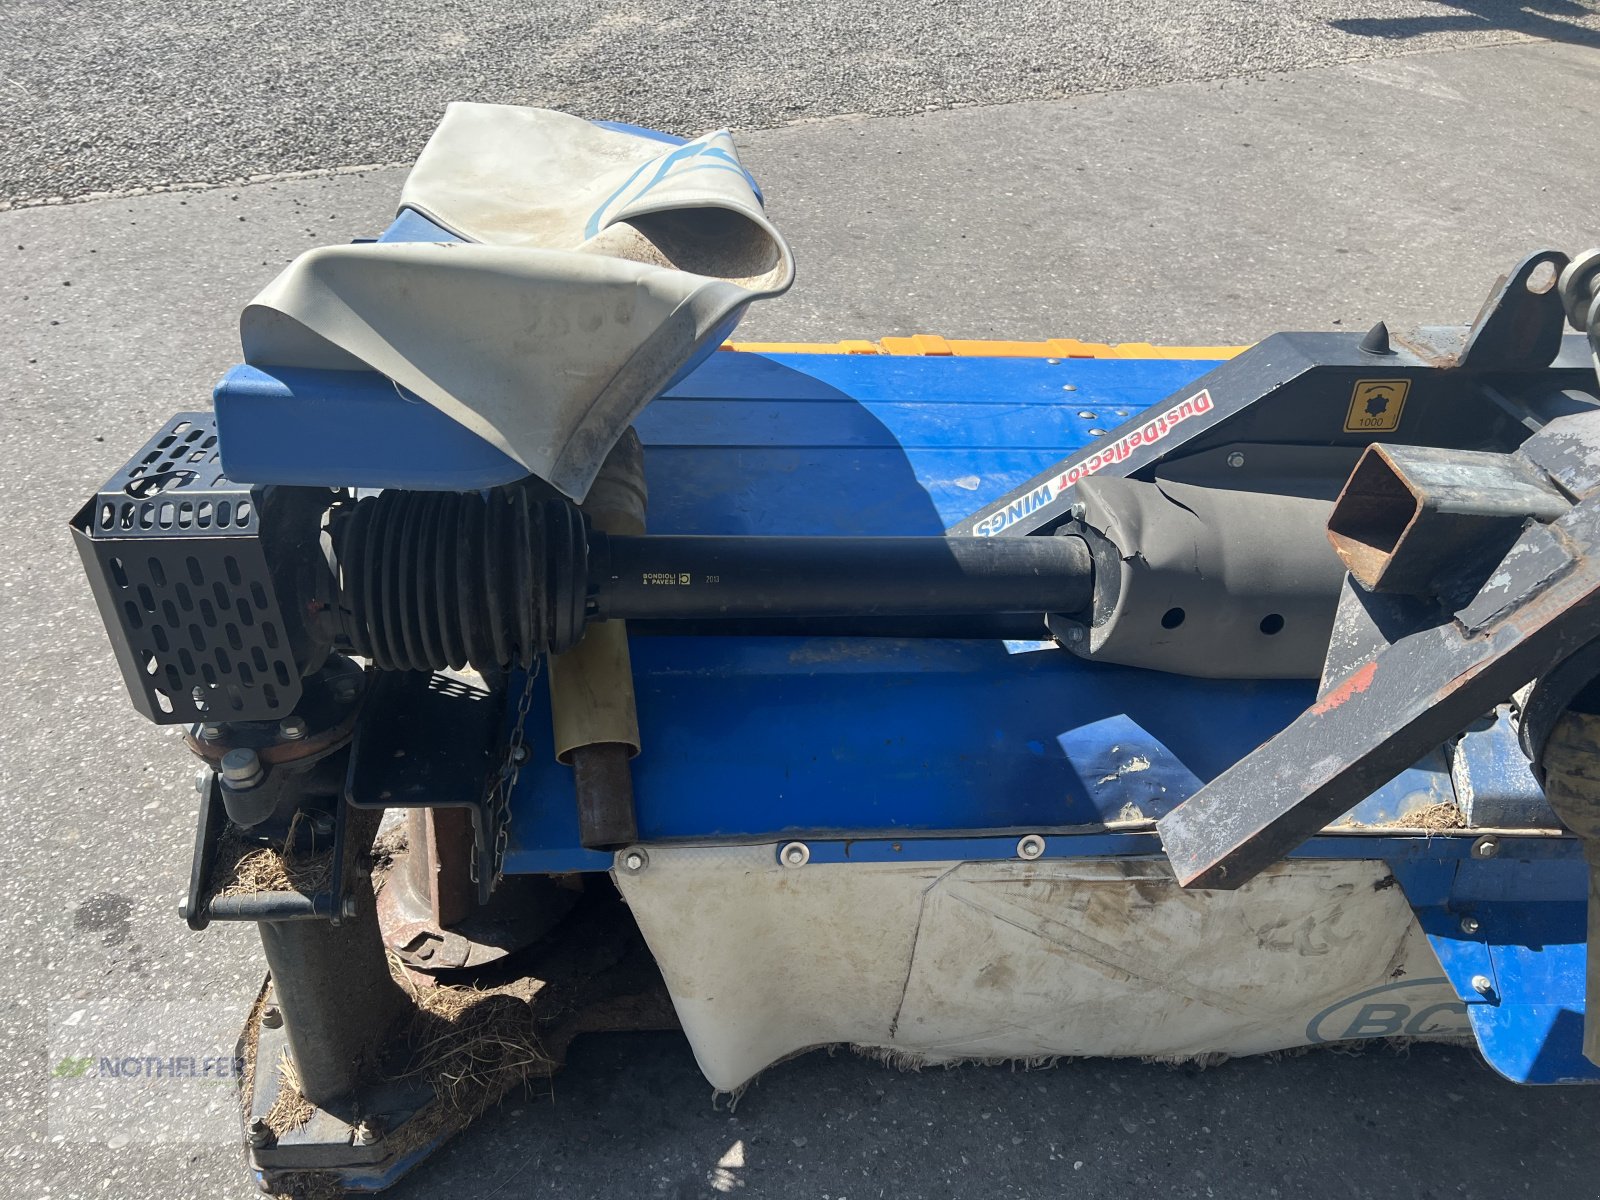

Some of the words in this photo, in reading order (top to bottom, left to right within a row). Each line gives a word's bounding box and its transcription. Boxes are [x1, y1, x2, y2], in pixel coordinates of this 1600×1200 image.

[1058, 391, 1212, 490] DustDeflector
[1360, 418, 1383, 426] 1000
[976, 487, 1053, 537] WINGS
[1339, 1002, 1476, 1038] BC
